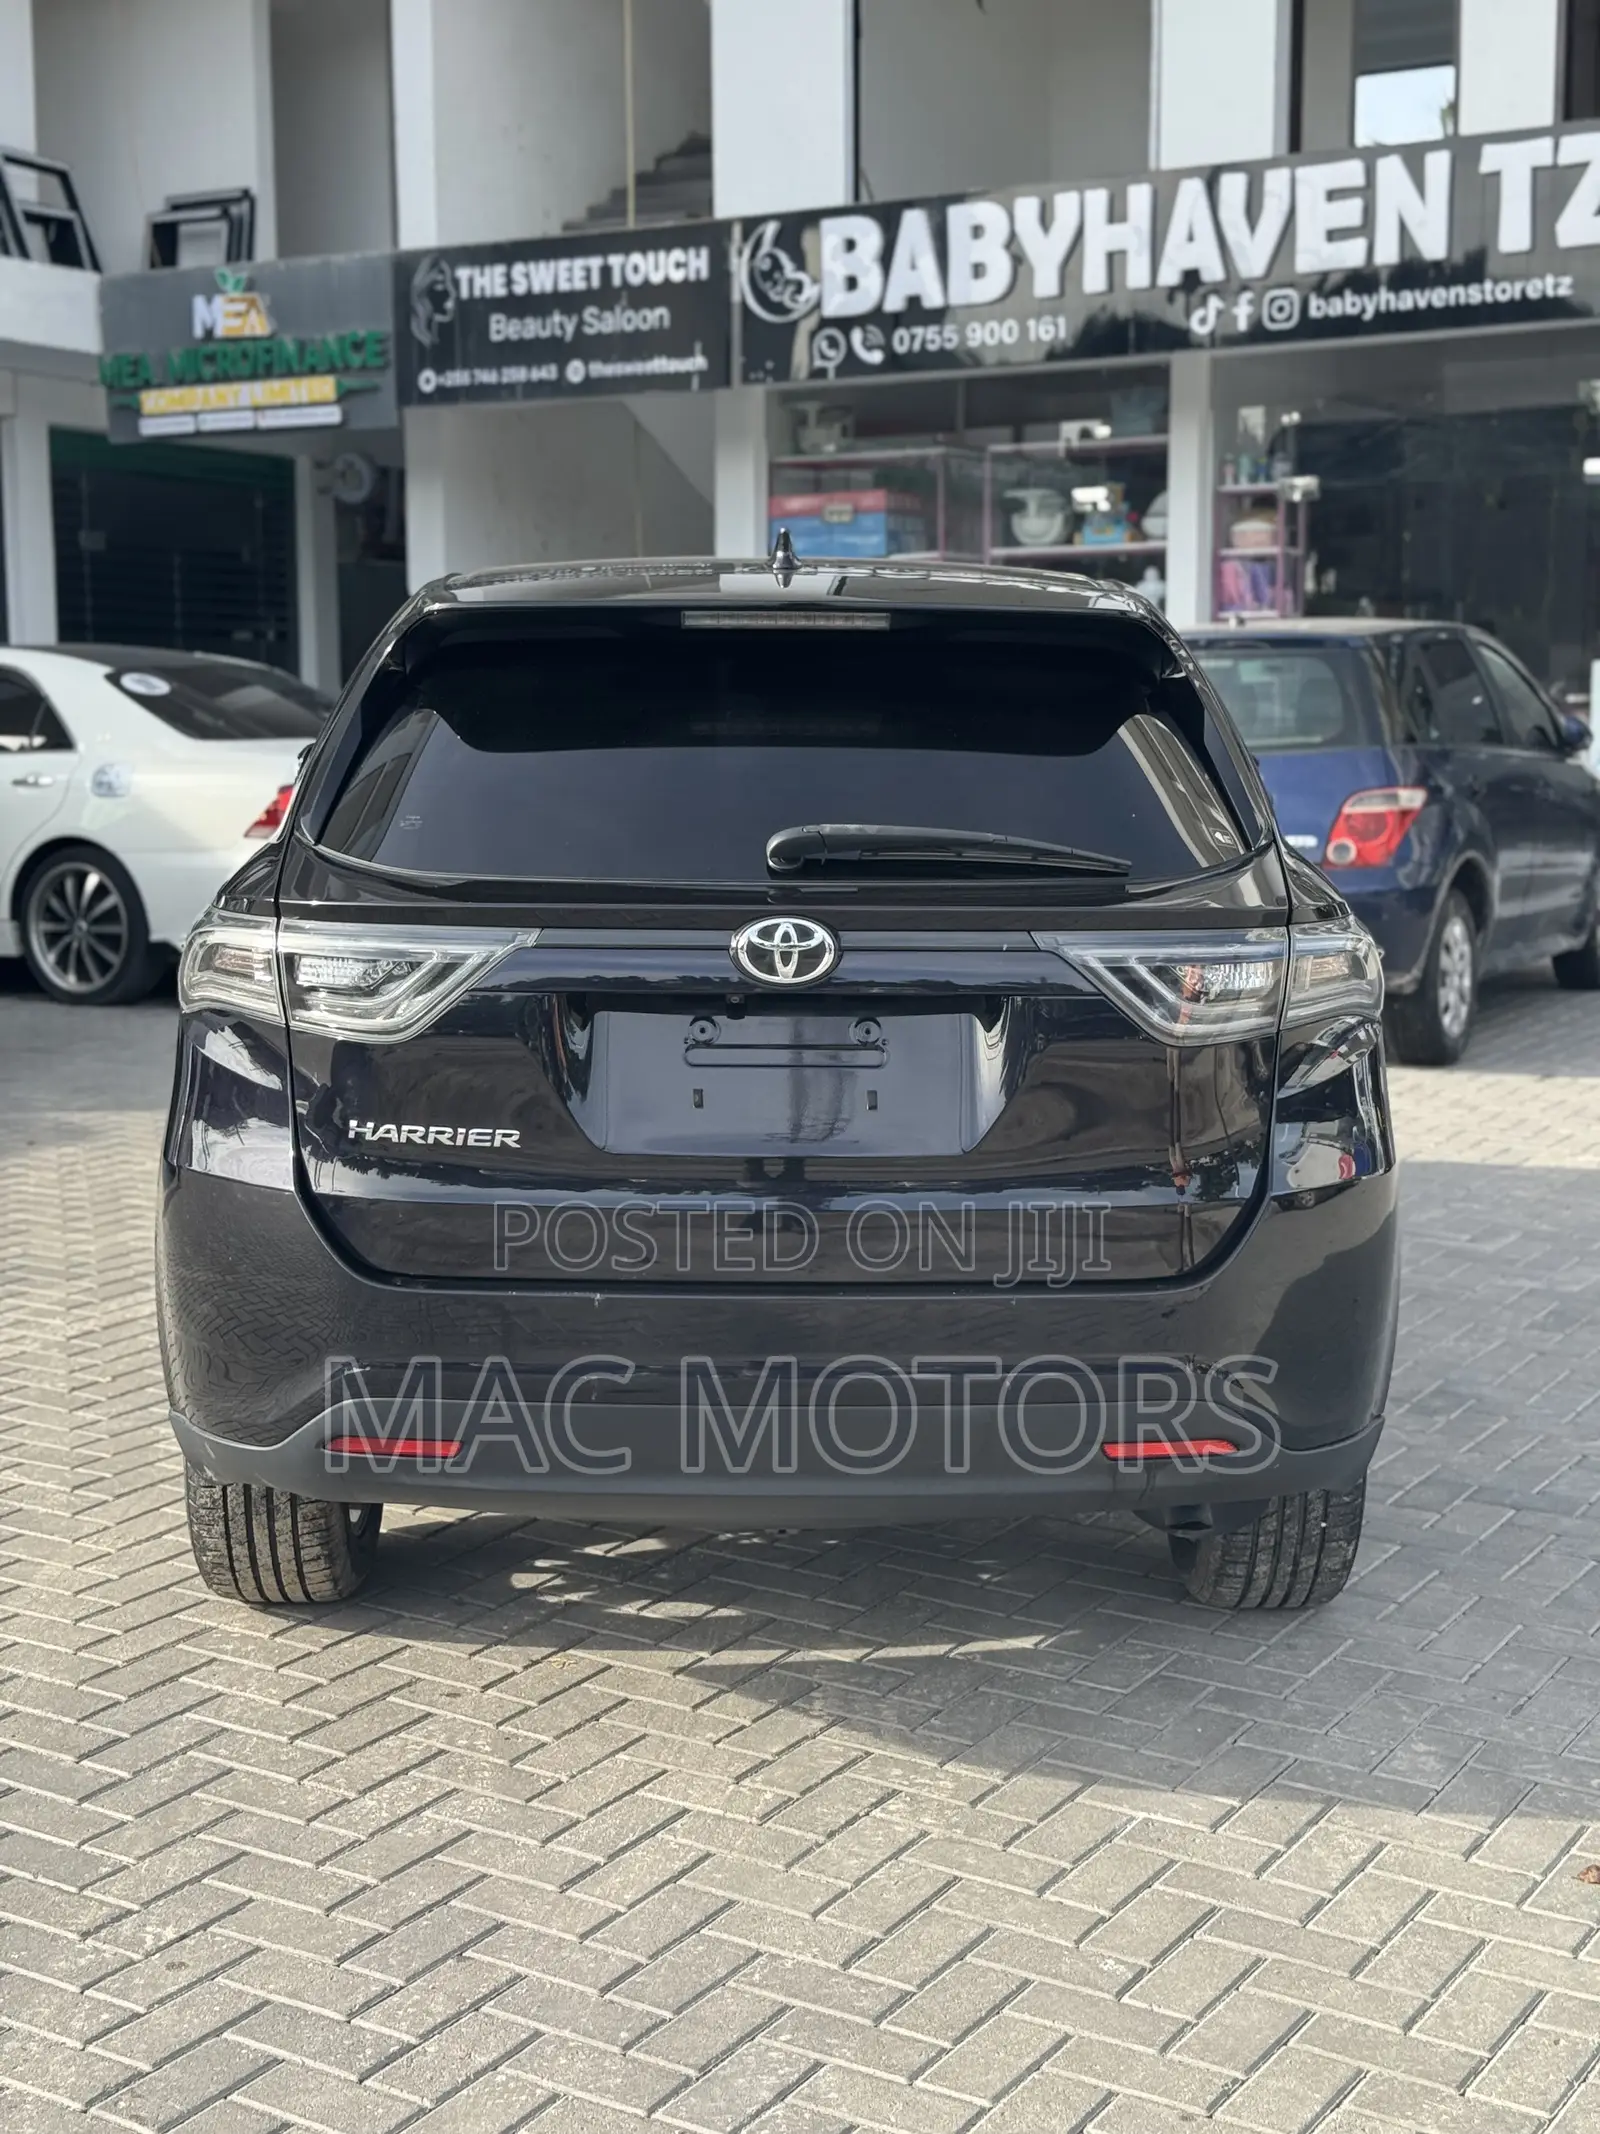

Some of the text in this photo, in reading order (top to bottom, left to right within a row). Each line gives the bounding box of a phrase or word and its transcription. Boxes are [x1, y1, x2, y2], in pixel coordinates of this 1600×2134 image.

[818, 131, 1600, 319] BABYHAVEN TZ
[455, 246, 710, 300] THE SWEET TOUCH
[191, 294, 272, 338] MEA
[1307, 273, 1574, 322] babyhavenstoretz
[488, 303, 672, 343] Beauty Saloon
[892, 314, 1067, 355] 0755 900 161
[99, 331, 385, 388] MEA MICROFINANCE
[347, 1118, 522, 1149] HARRIER
